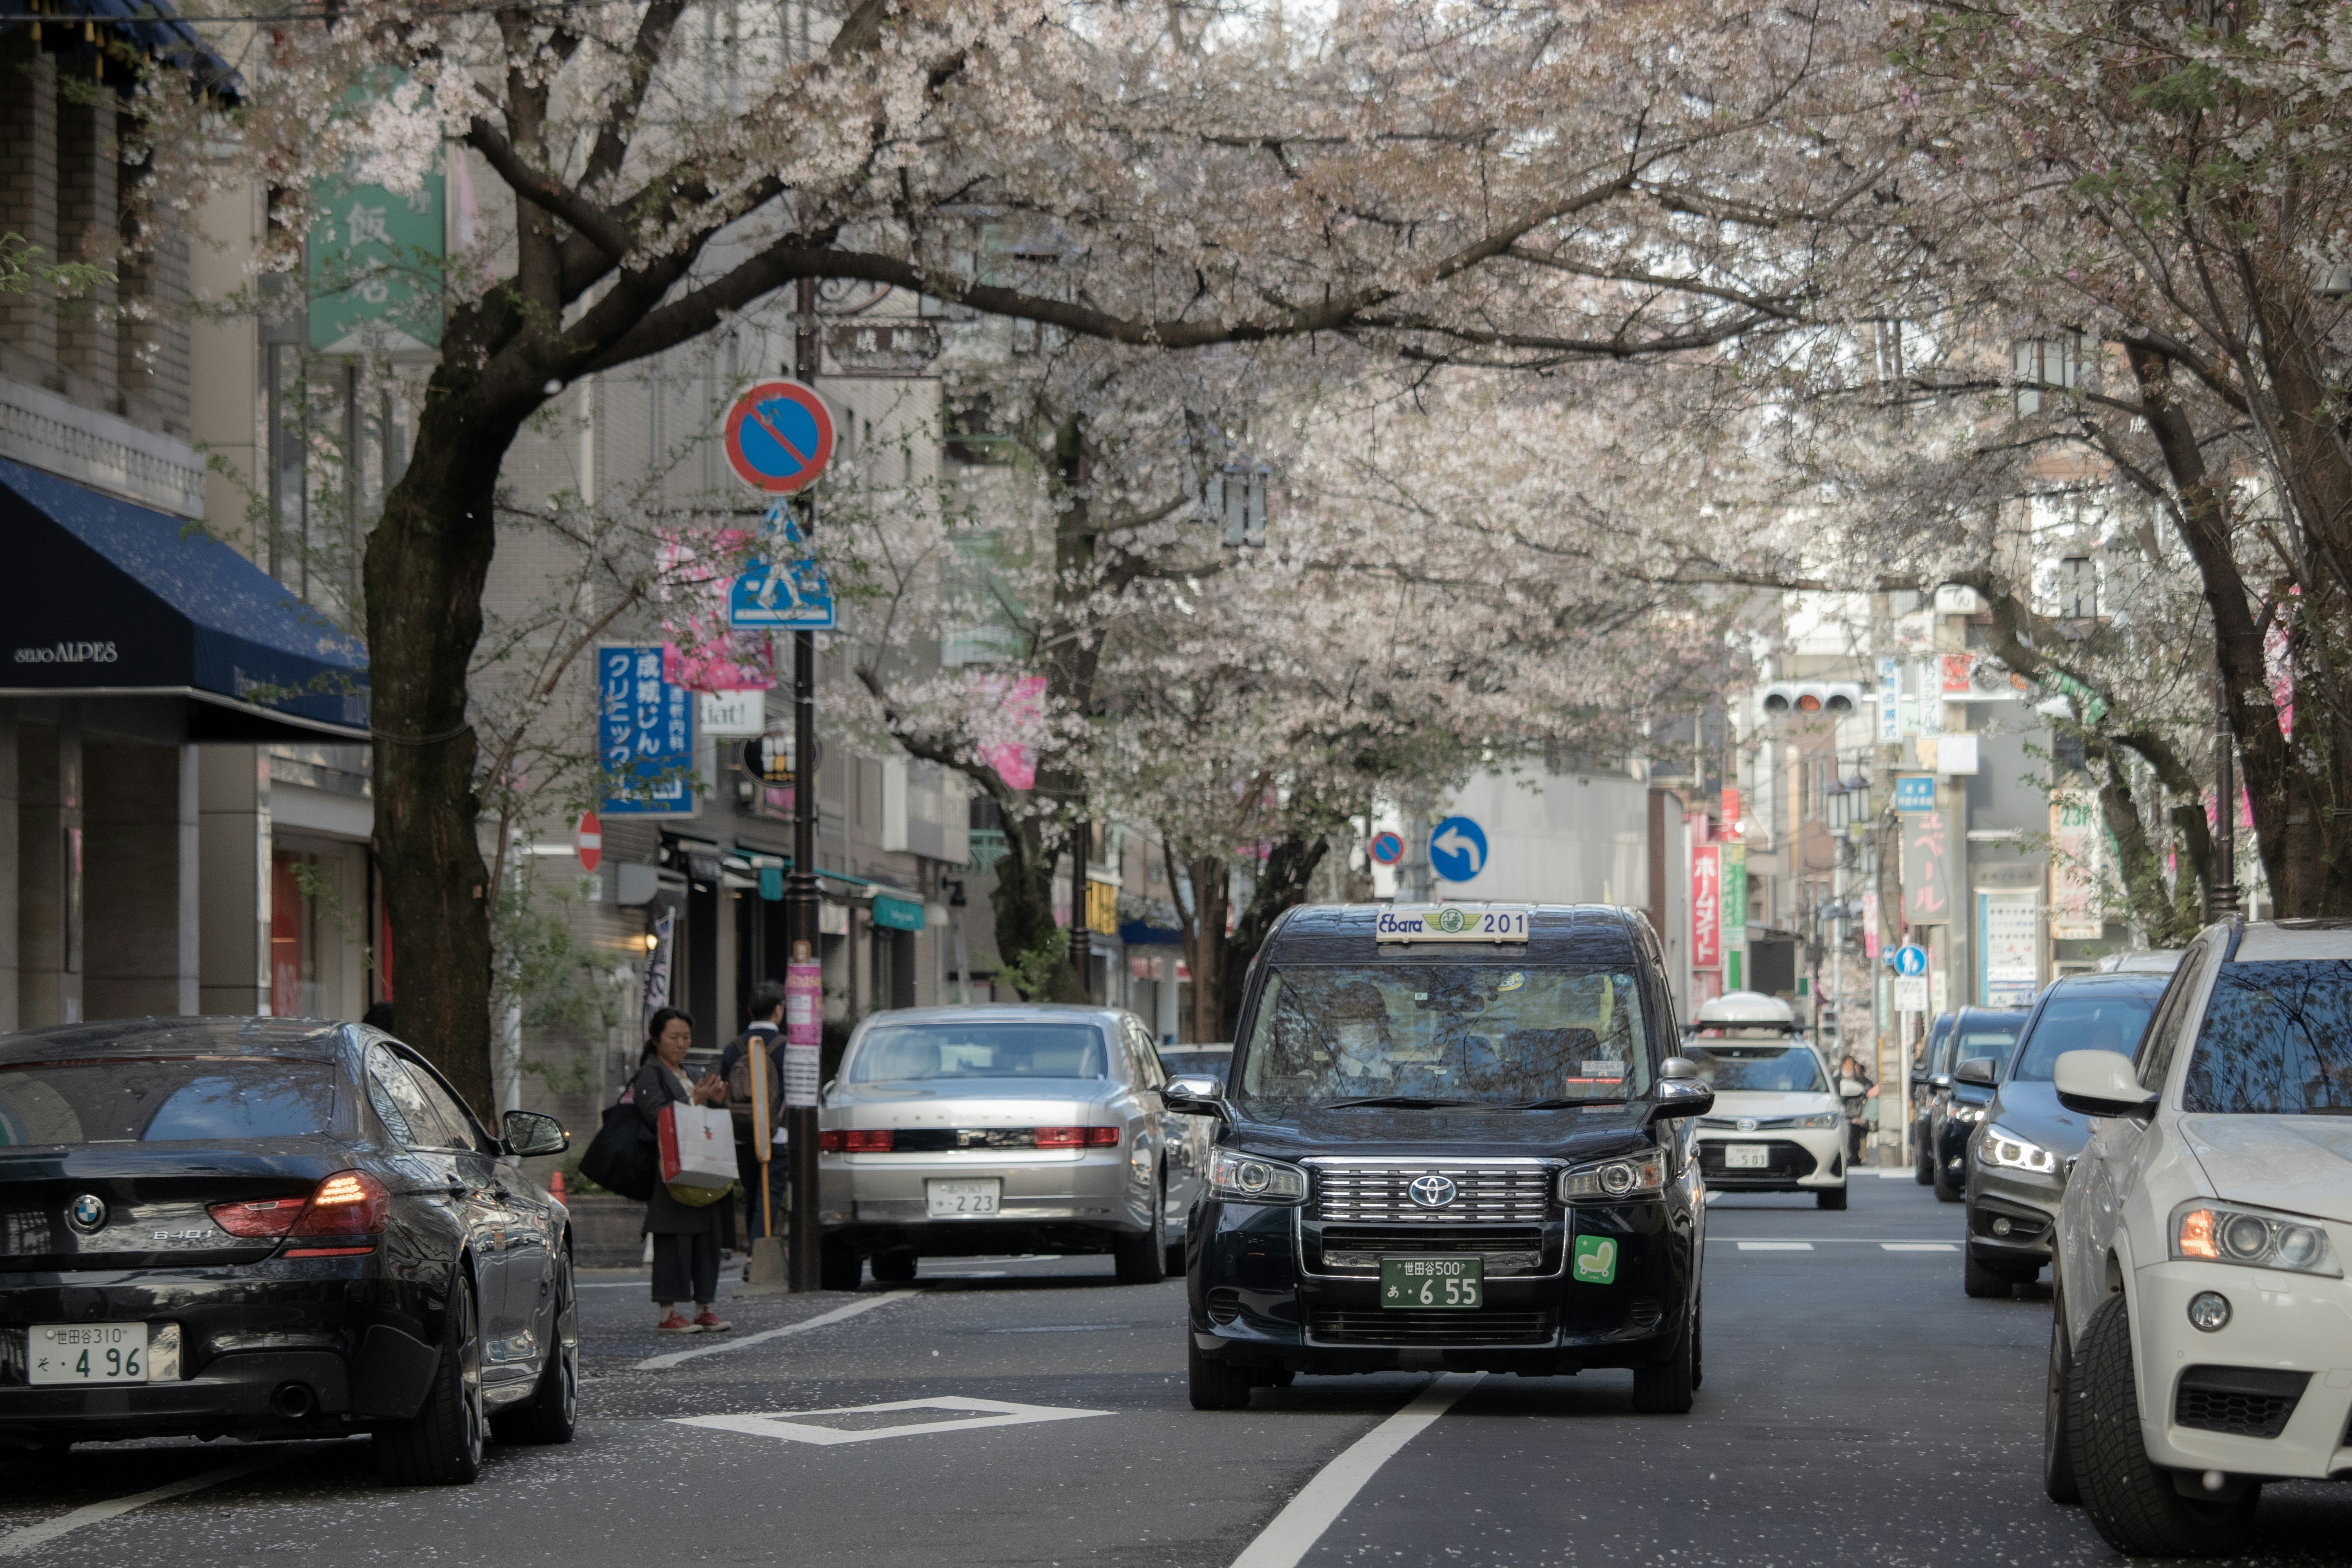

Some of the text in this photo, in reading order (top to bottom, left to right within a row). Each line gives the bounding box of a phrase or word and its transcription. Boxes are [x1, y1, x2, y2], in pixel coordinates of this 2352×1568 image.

[55, 641, 119, 663] ALPES
[636, 653, 661, 755] 成城じん
[1694, 855, 1717, 963] ホームメイト
[1379, 914, 1423, 933] Ebara
[1484, 914, 1523, 933] 201
[153, 1229, 213, 1240] 640i
[1404, 1261, 1460, 1276] 世田谷500
[1387, 1285, 1399, 1298] あ
[57, 1328, 122, 1345] 世田谷310
[37, 1357, 51, 1372] そ
